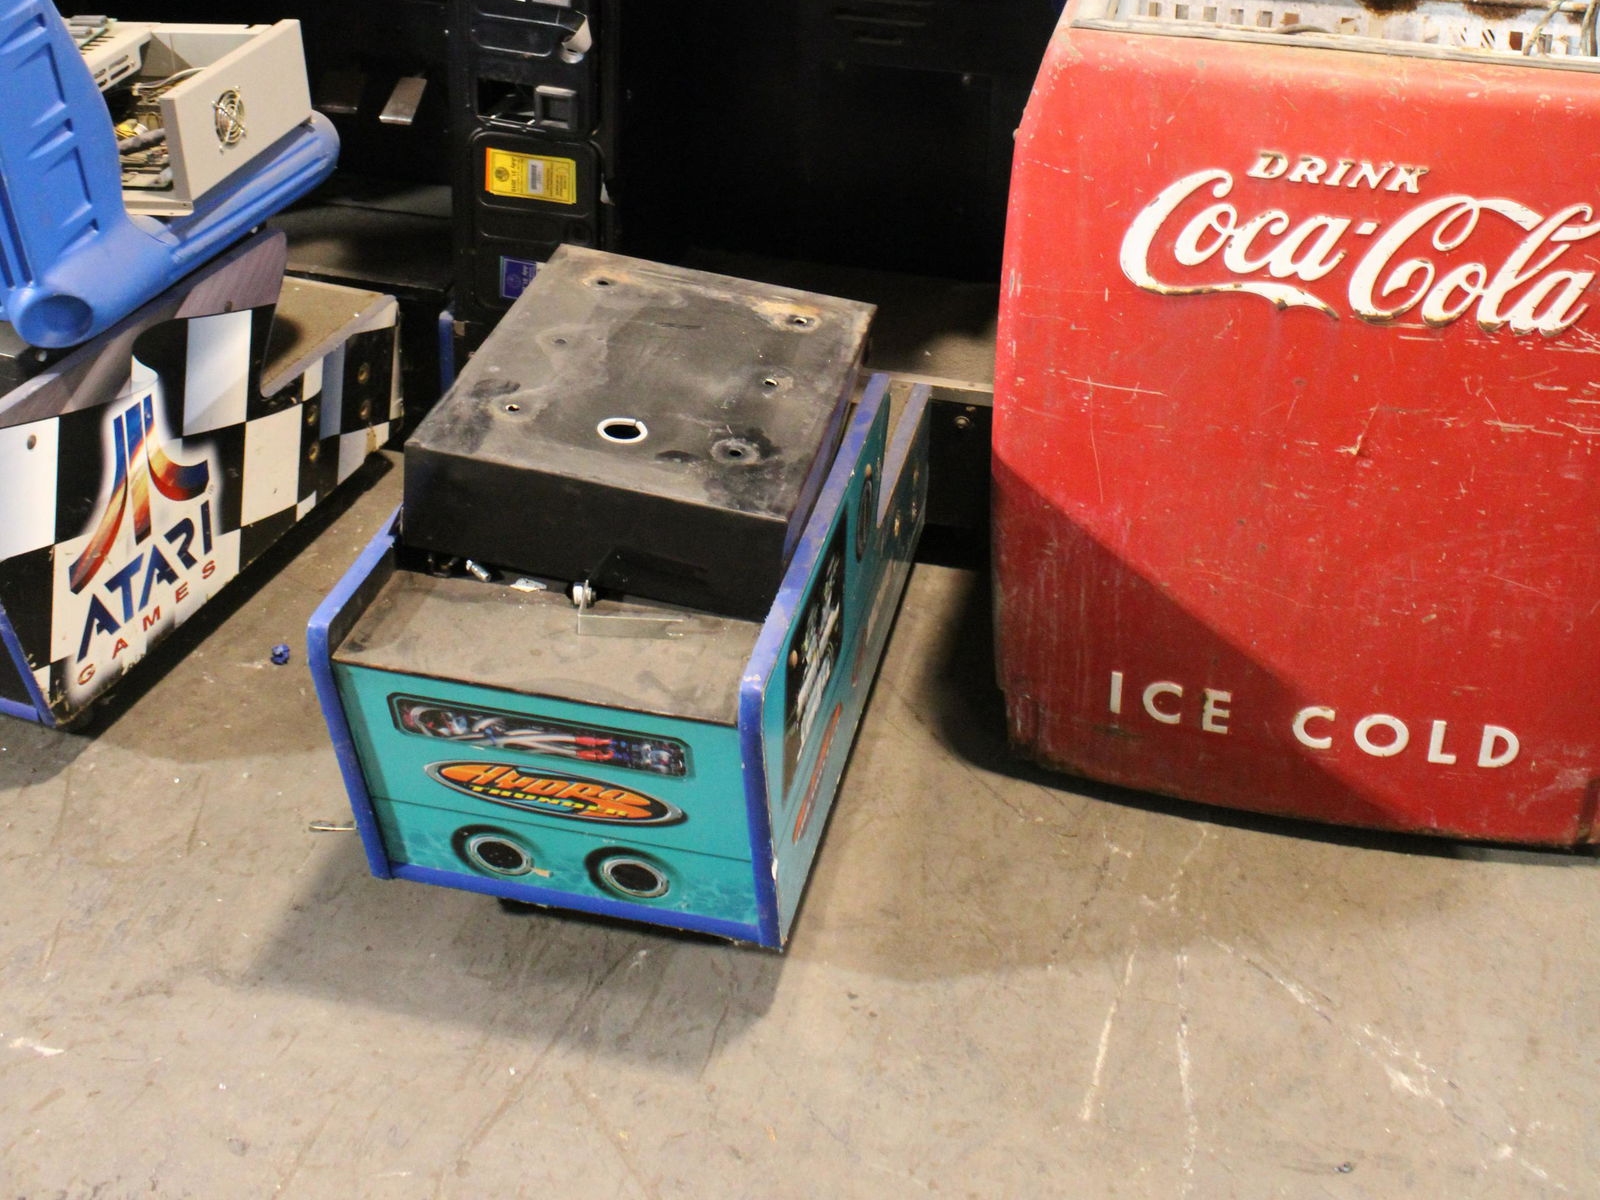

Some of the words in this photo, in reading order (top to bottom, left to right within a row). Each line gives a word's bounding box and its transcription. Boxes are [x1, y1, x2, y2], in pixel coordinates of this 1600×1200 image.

[1247, 150, 1430, 194] DRINK
[1119, 169, 1600, 338] Coca-Cola
[76, 499, 214, 663] ATARI
[77, 559, 217, 686] GAMES
[1109, 670, 1233, 736] ICE
[1291, 705, 1521, 769] COLD
